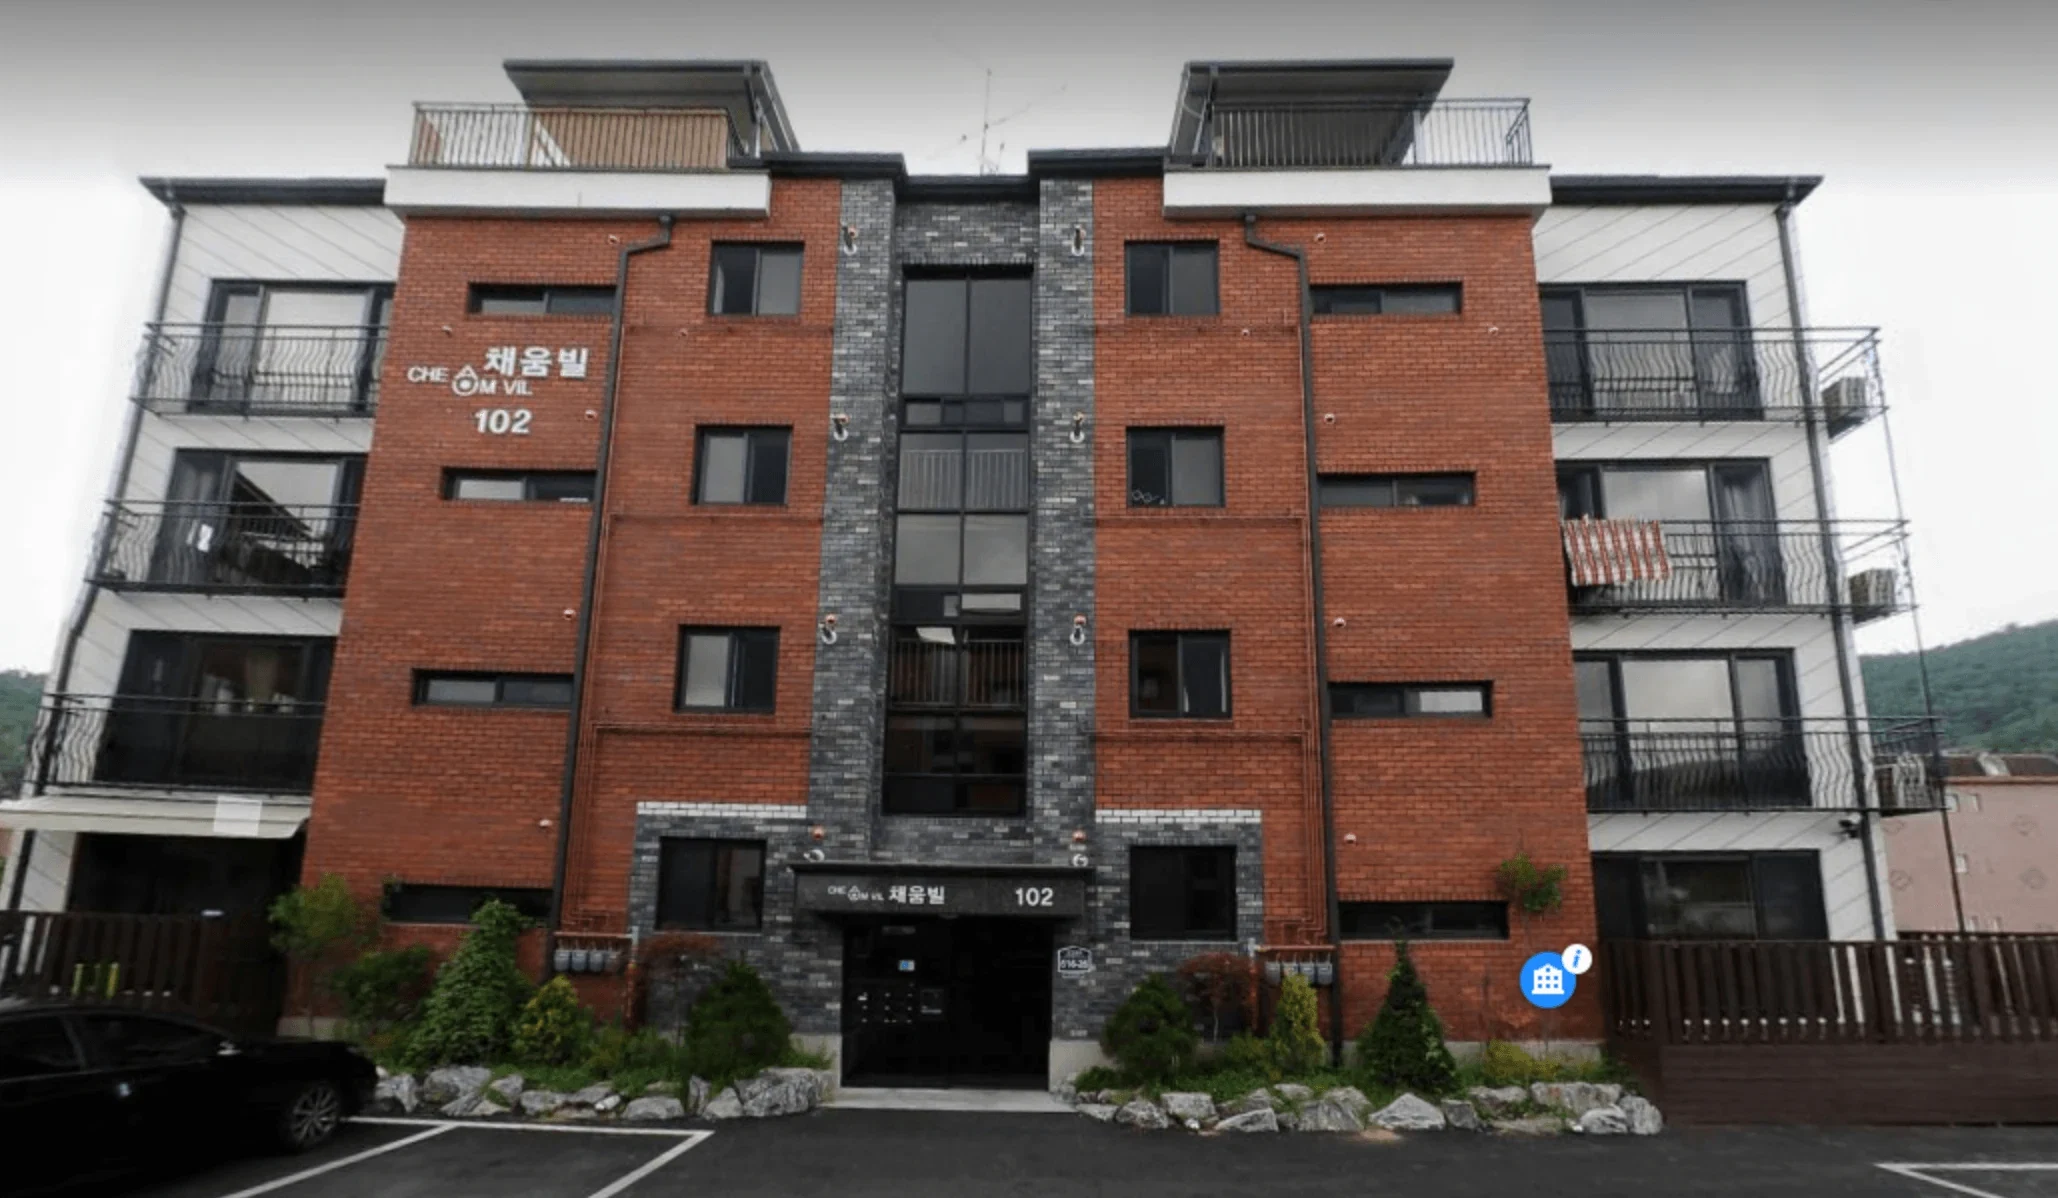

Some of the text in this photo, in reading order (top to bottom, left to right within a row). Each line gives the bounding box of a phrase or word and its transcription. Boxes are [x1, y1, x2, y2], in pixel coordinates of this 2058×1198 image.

[484, 346, 589, 378] 채움빌
[407, 366, 449, 383] CHE
[475, 408, 533, 434] 102
[888, 885, 945, 905] 채움빌
[1015, 887, 1054, 906] 102
